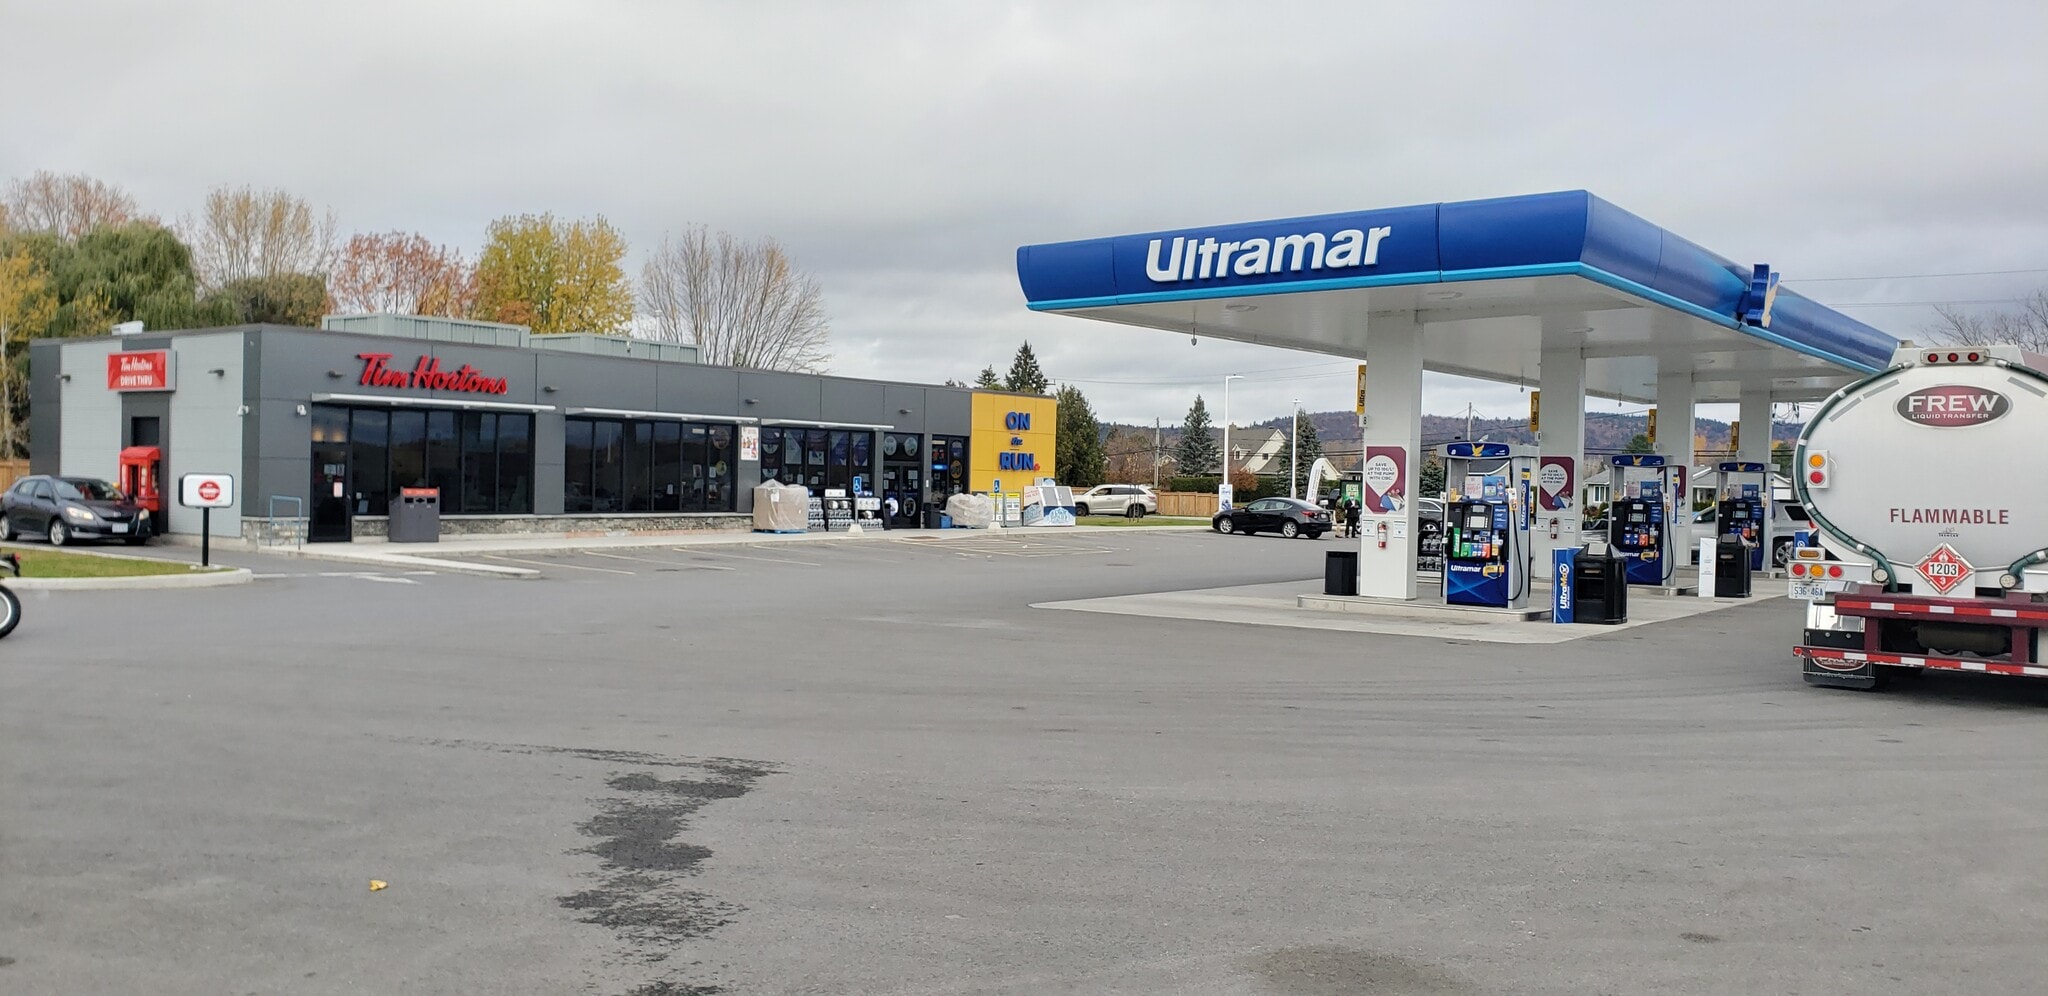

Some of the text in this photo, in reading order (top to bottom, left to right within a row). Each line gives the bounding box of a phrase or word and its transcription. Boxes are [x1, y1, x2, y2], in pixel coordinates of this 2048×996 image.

[1146, 226, 1391, 282] Ultramar
[120, 374, 153, 387] DRIVE THRU
[356, 353, 508, 395] Tim Hortons
[1908, 394, 1999, 413] FREW
[1005, 411, 1031, 431] ON
[1010, 437, 1023, 446] the
[999, 452, 1034, 471] RUN
[1890, 508, 2009, 524] FLAMMABLE
[1930, 563, 1958, 576] 1203
[1559, 563, 1569, 610] UltraMax
[1939, 577, 1946, 585] 3
